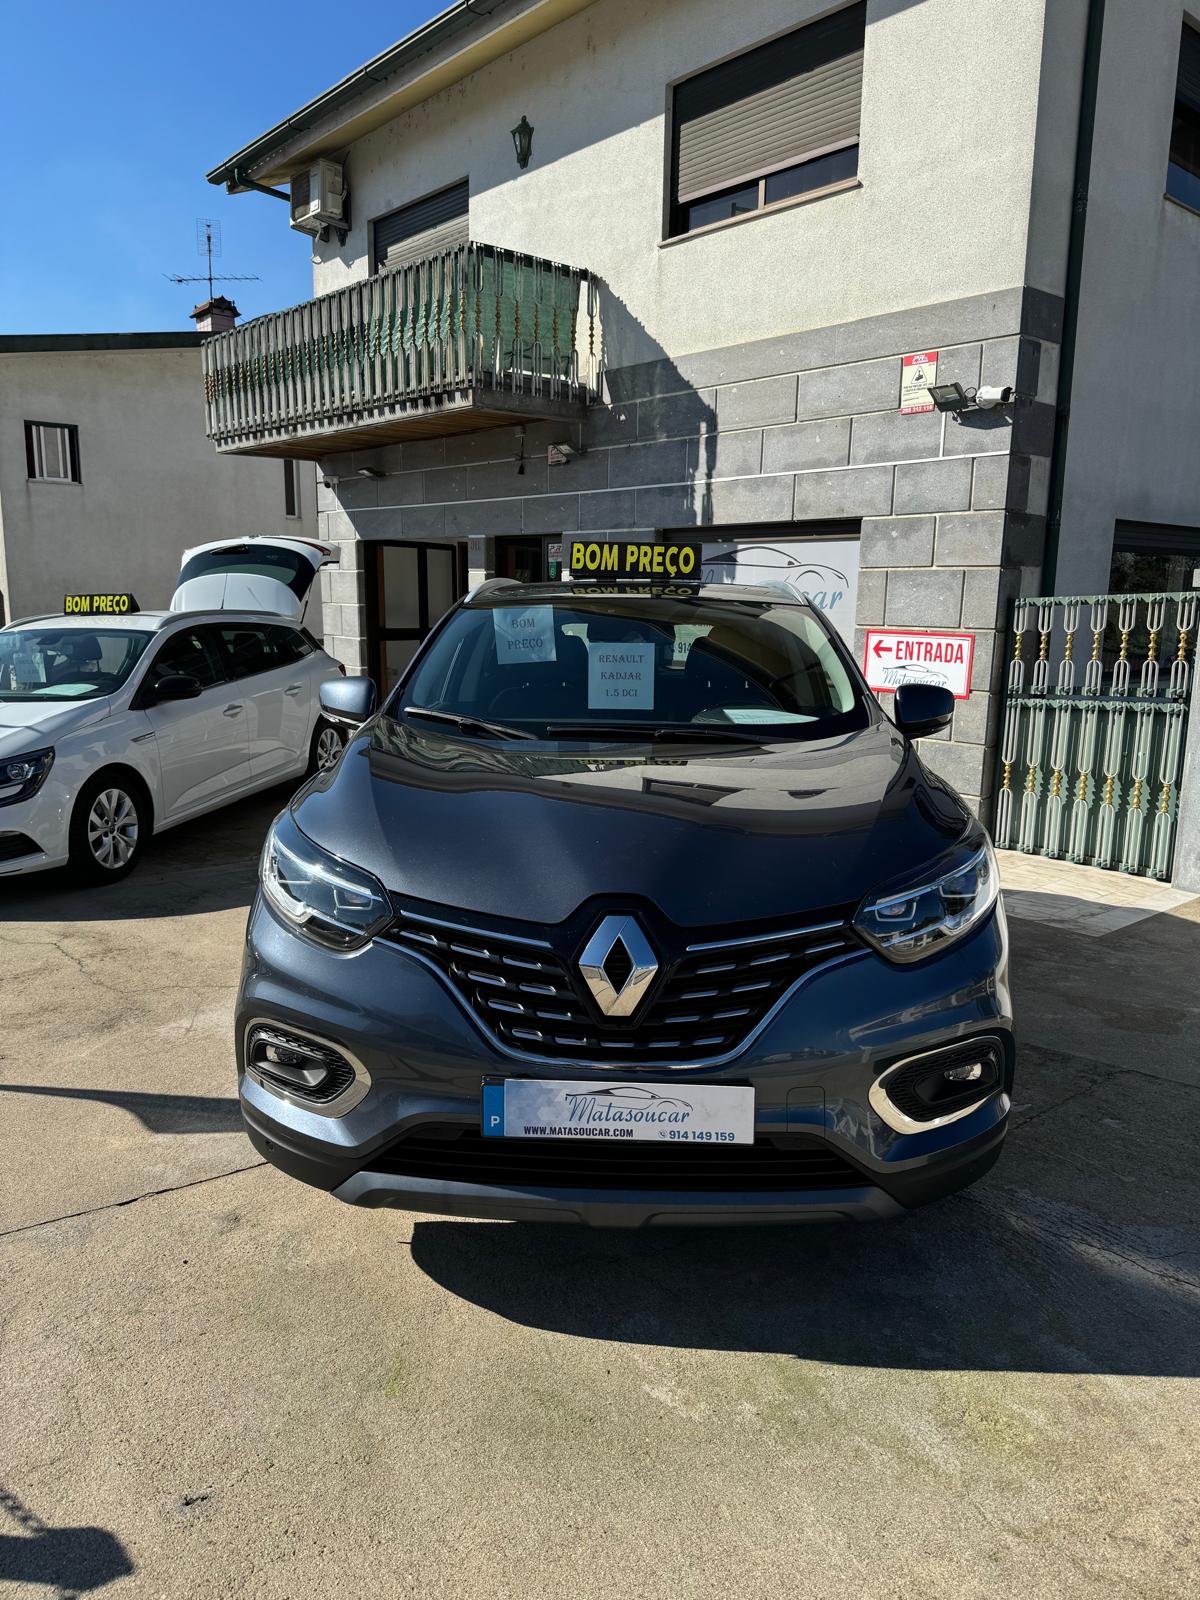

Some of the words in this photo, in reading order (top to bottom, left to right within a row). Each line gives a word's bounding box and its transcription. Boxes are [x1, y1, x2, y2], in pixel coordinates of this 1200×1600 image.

[572, 543, 619, 571] BOM
[625, 545, 695, 577] PREÇO
[66, 596, 90, 613] BOM
[93, 595, 128, 614] PREÇO
[511, 618, 536, 629] BOM
[507, 638, 544, 651] PREÇO
[895, 640, 964, 664] ENTRADA
[599, 654, 645, 664] RENAULT
[600, 671, 642, 681] KADJAR
[606, 688, 620, 697] 1.5
[622, 688, 638, 697] DCI
[567, 1096, 690, 1124] Matasoucar
[490, 1115, 500, 1127] P
[523, 1125, 634, 1138] WWW.MATASOUCAR.COM
[669, 1130, 689, 1140] 914
[692, 1131, 712, 1141] 149
[715, 1132, 735, 1142] 159
